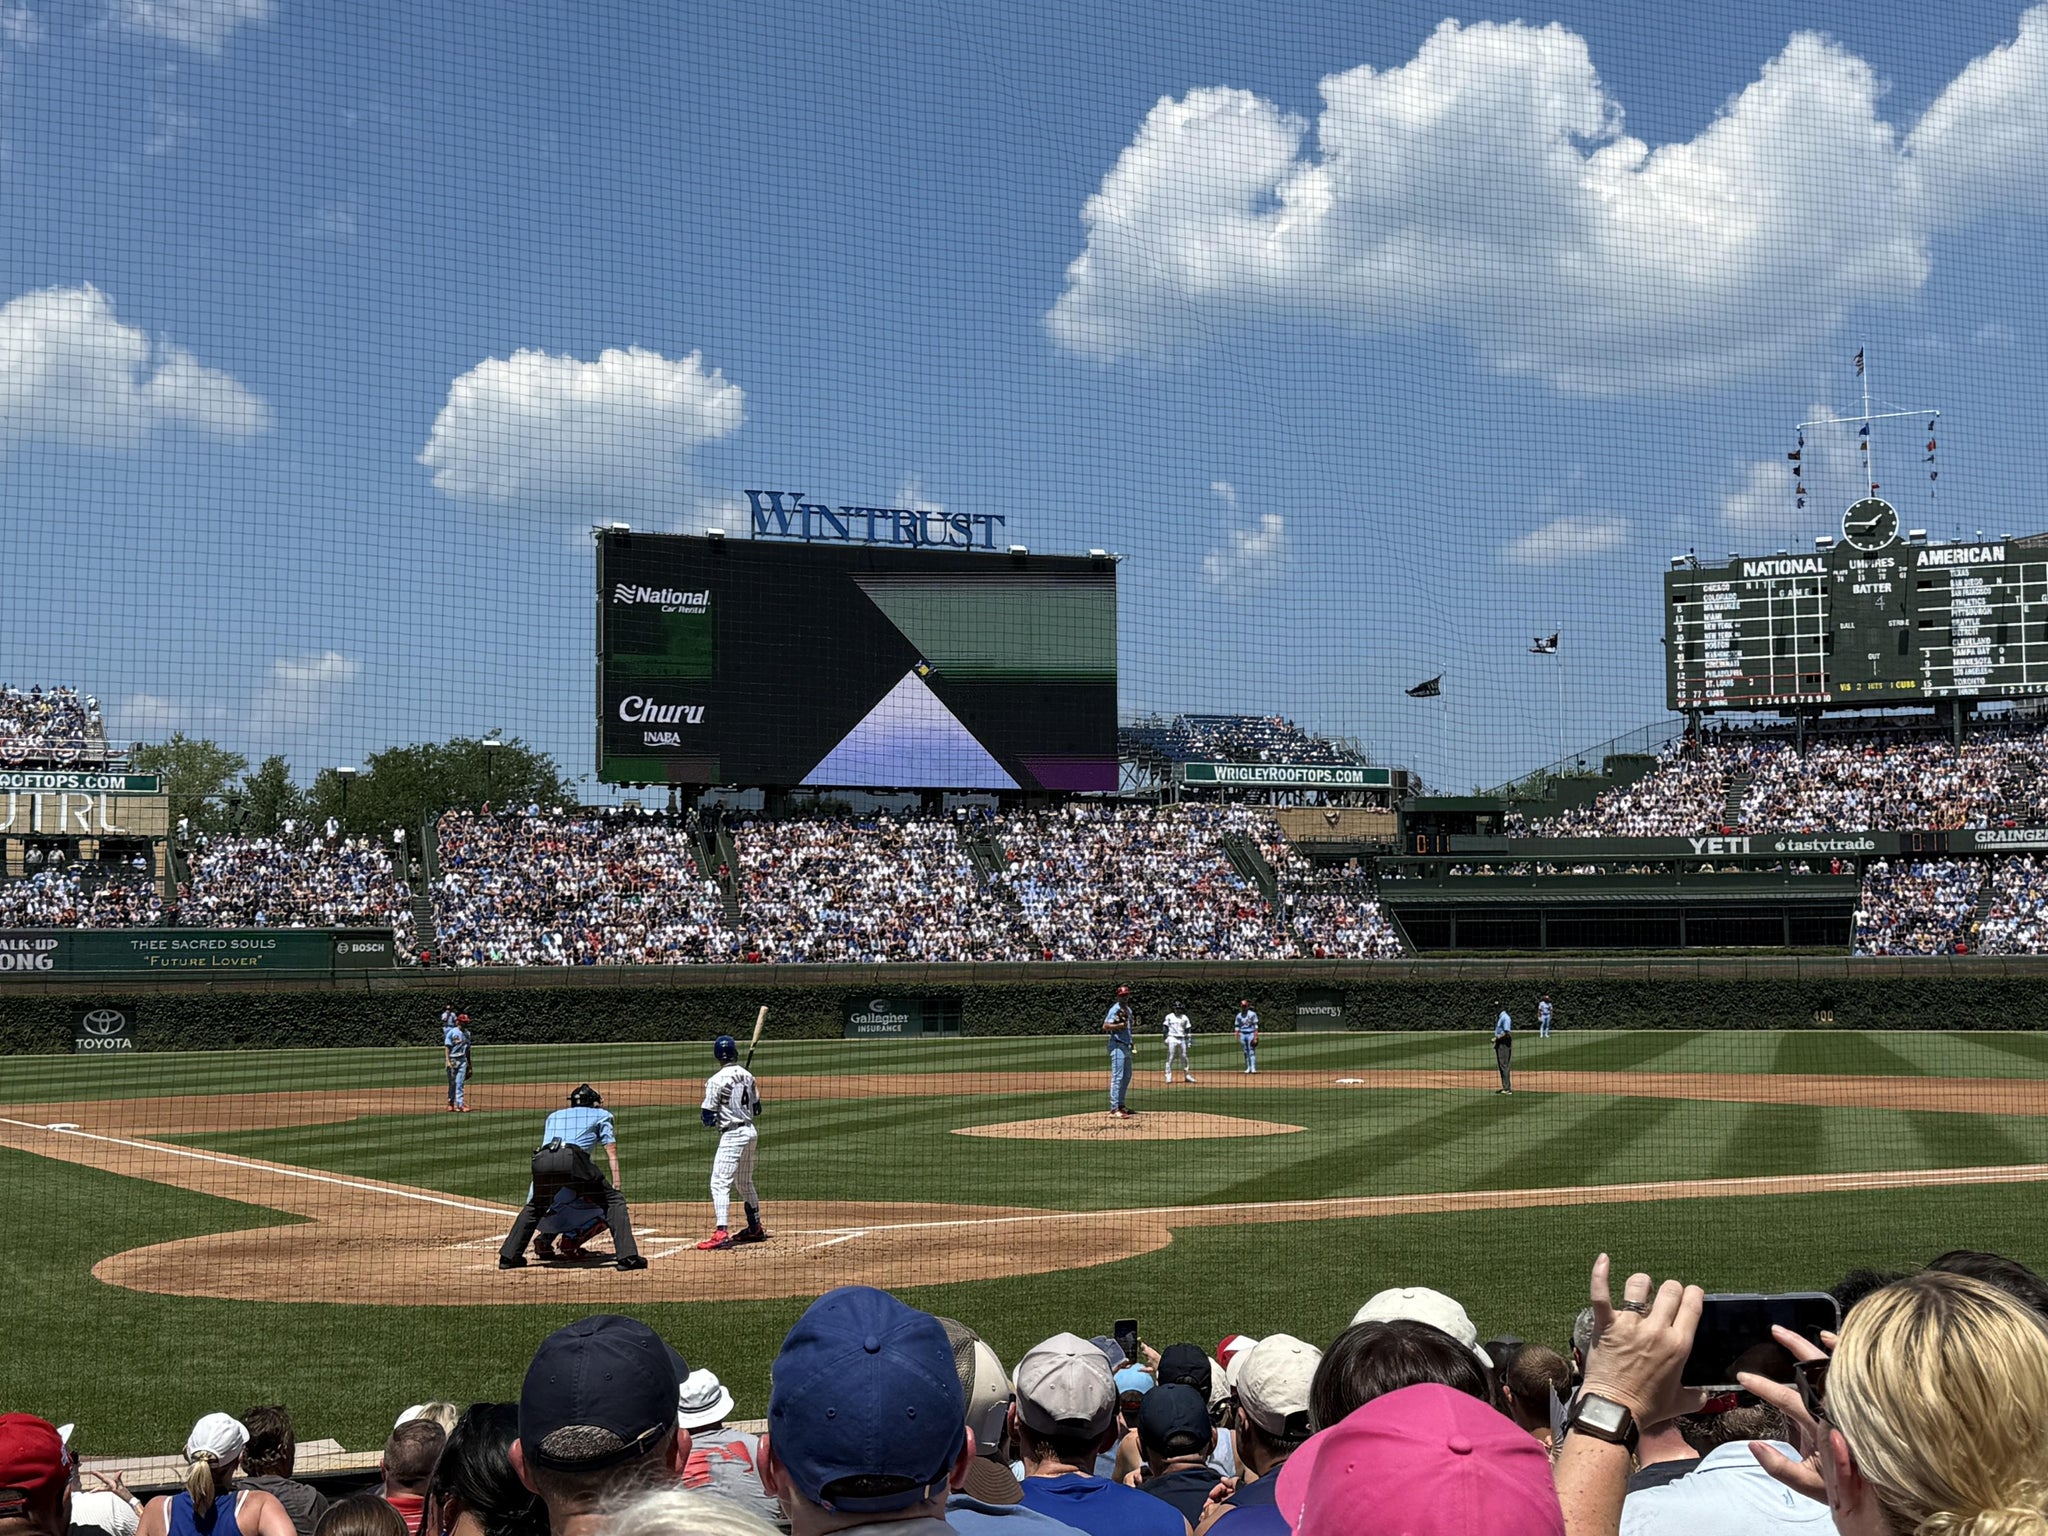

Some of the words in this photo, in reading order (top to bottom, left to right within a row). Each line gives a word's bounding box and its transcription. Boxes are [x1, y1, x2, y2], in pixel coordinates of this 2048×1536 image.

[744, 489, 1005, 550] WINTRUST
[1917, 546, 2005, 566] AMERICAN
[1743, 557, 1828, 577] NATIONAL
[1849, 557, 1895, 569] UMPIRES
[1964, 578, 1984, 586] DIEGO
[1853, 583, 1892, 594] BATTER
[1703, 593, 1737, 602] COLORADO
[1703, 602, 1740, 611] MILWAUKEE
[1875, 595, 1885, 611] 4
[1951, 598, 1986, 607] ATHLETICS
[1704, 641, 1730, 650] BOSTON
[1952, 637, 1991, 646] CLEVELAND
[1953, 647, 1975, 656] TAMPA
[1977, 647, 1990, 655] BAY
[1953, 657, 1992, 666] MINNESOTA
[1716, 679, 1734, 688] LOUIS
[1895, 680, 1916, 689] CUBS
[1954, 677, 1985, 686] TORONTO
[1706, 690, 1724, 698] CUBS
[2009, 686, 2016, 694] 2
[2027, 685, 2033, 693] 4
[2036, 685, 2042, 693] 5
[1782, 696, 1788, 704] 5
[1807, 695, 1813, 703] 8
[1823, 694, 1832, 703] 10
[619, 695, 705, 724] Churu
[644, 731, 681, 743] INABA
[1214, 765, 1363, 783] WRIGLEYROOFTOPS.COM
[1688, 837, 1750, 855] YETI
[1787, 837, 1875, 853] tastytrade
[131, 940, 167, 951] THEE
[171, 939, 227, 950] SACRED
[230, 939, 276, 949] SOULS
[352, 943, 385, 952] BOSCH
[851, 1013, 909, 1025] Gallagher
[1813, 1010, 1834, 1023] 400
[858, 1025, 902, 1033] INSURANCE
[75, 1038, 132, 1050] TOYOTA
